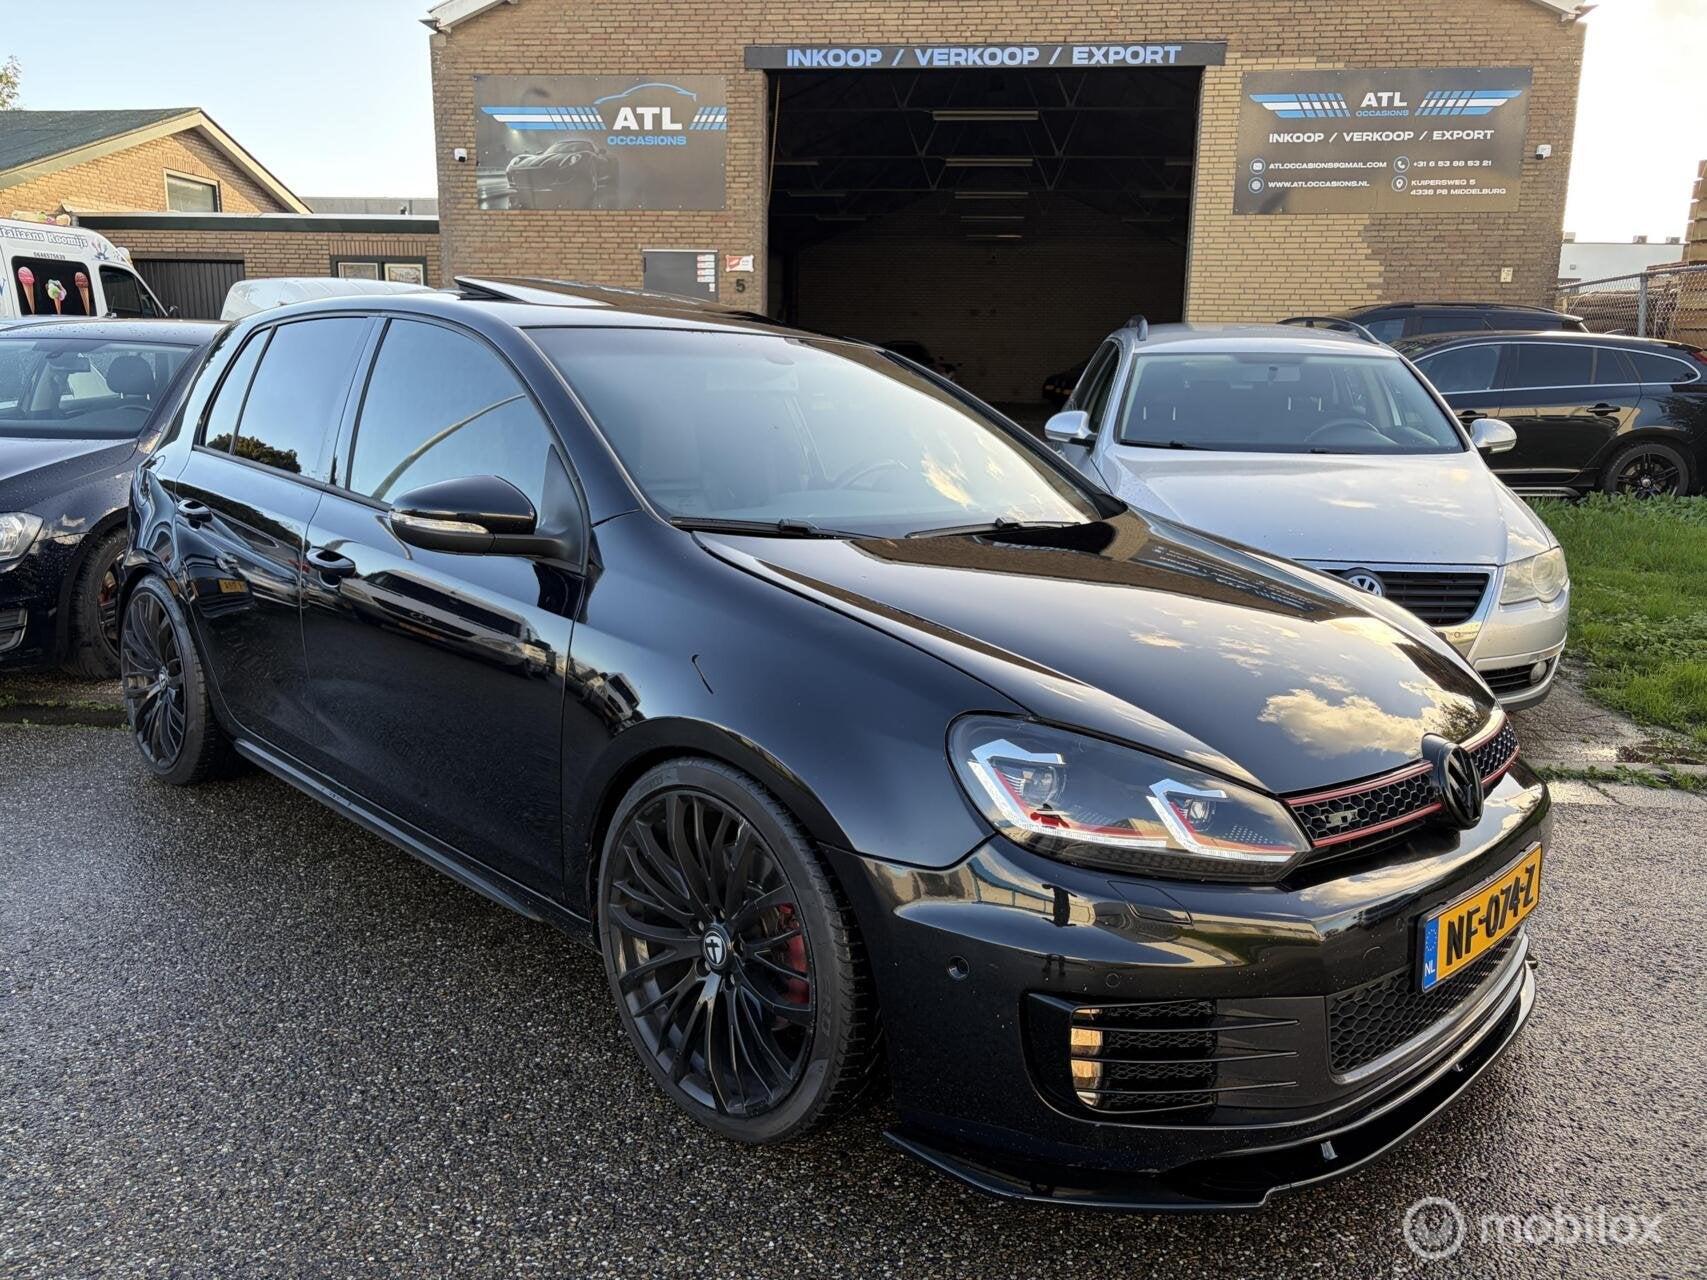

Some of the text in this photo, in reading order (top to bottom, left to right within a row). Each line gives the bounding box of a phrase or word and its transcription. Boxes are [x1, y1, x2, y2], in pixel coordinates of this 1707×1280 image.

[786, 45, 1183, 67] INKOOP / VERKOOP / EXPORT
[1360, 91, 1408, 108] ATL
[612, 106, 683, 131] ATL
[1355, 109, 1410, 118] OCCASIONS
[607, 135, 687, 146] OCCASIONS
[1269, 129, 1495, 144] INKOOP / VERKOOP / EXPORT
[1413, 160, 1427, 168] +31
[1267, 180, 1371, 189] WWW.ATLOCCASIONS.NL
[1450, 187, 1507, 195] MIDDELBURG
[47, 233, 88, 248] Roomijs
[735, 278, 746, 293] 5
[1446, 863, 1536, 966] NF-074-Z
[1424, 959, 1436, 978] NL
